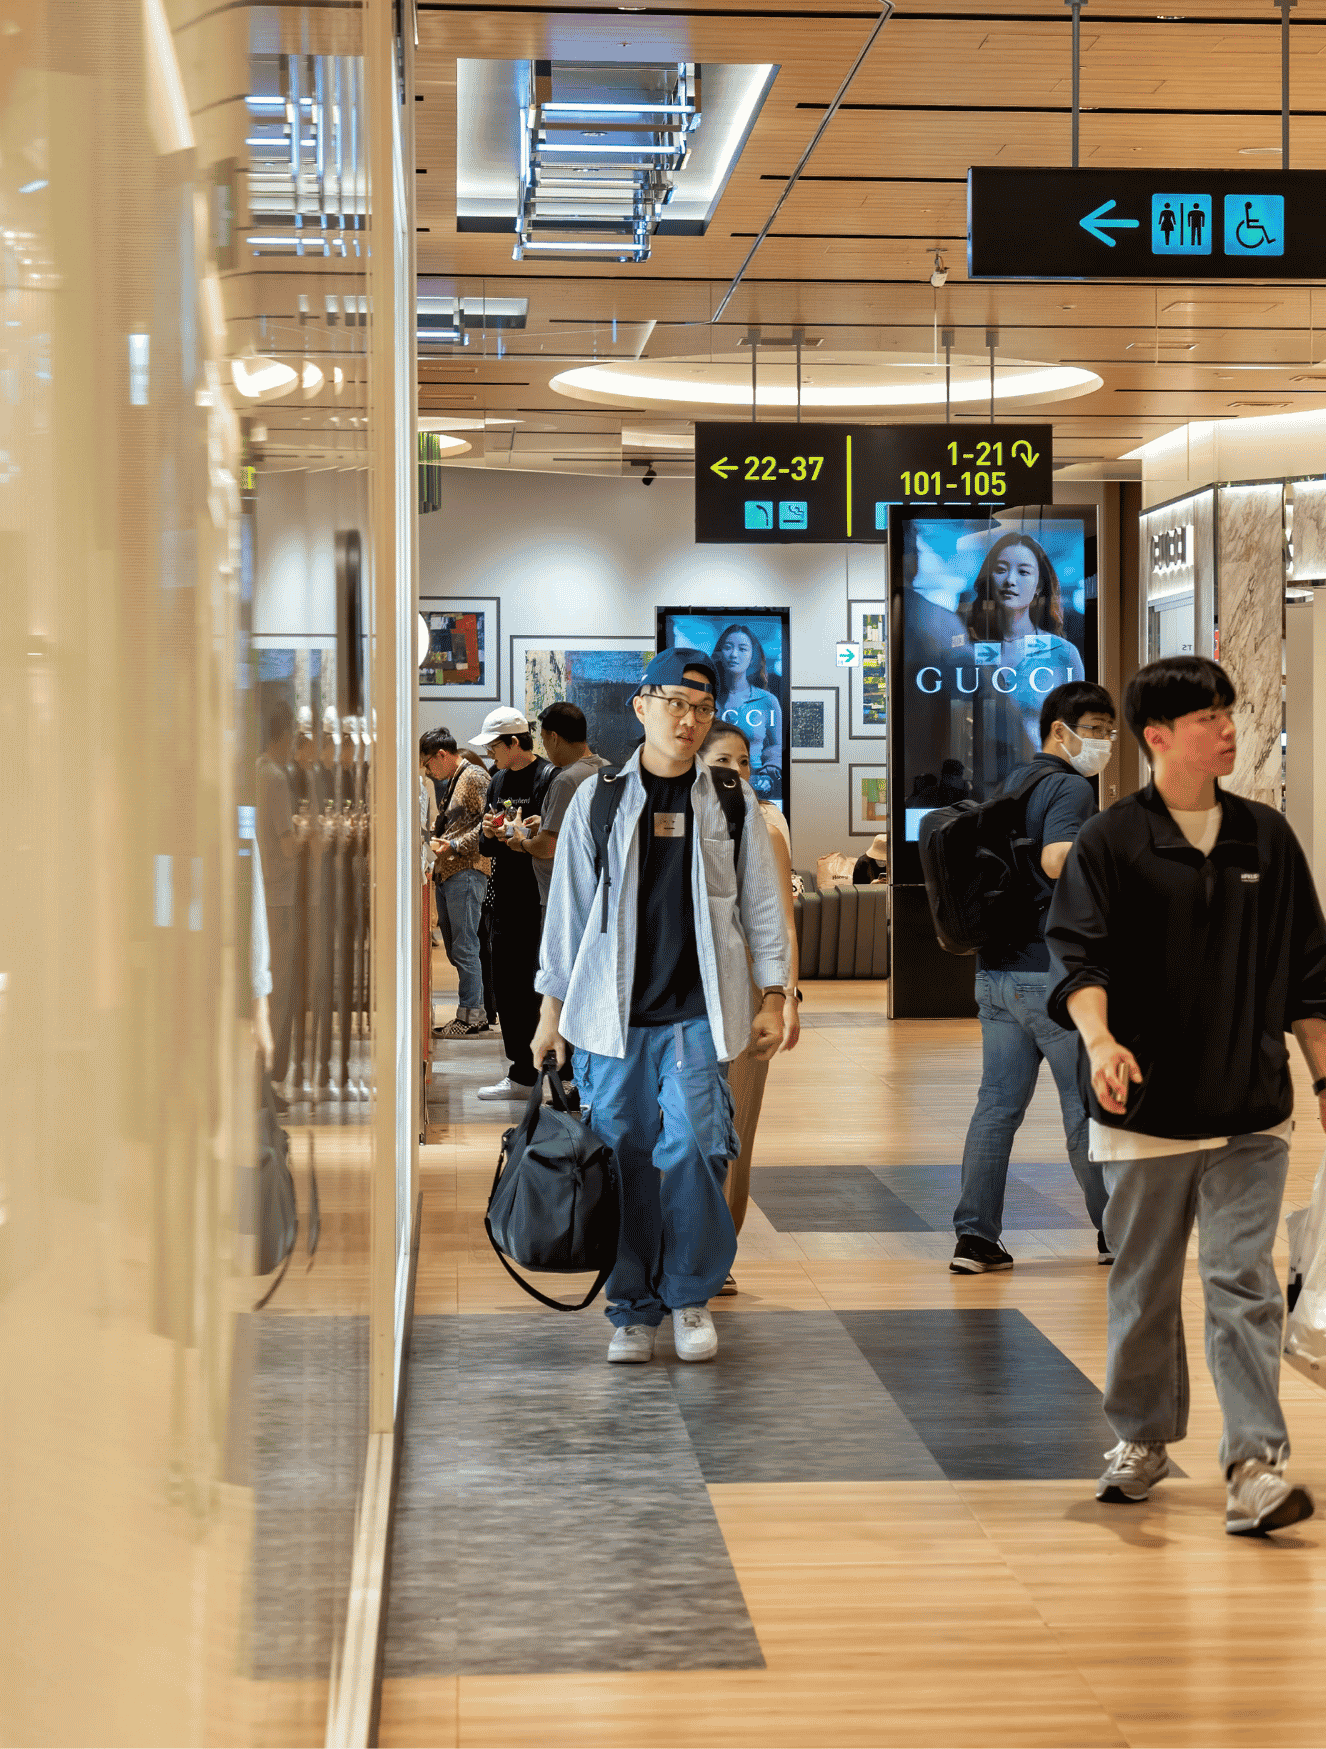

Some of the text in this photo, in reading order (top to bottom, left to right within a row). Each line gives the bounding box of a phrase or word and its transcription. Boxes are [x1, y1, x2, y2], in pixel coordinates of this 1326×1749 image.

[947, 441, 1003, 466] 1-21
[744, 456, 825, 481] 22-37
[899, 471, 1006, 496] 101-105
[722, 709, 774, 726] CCI
